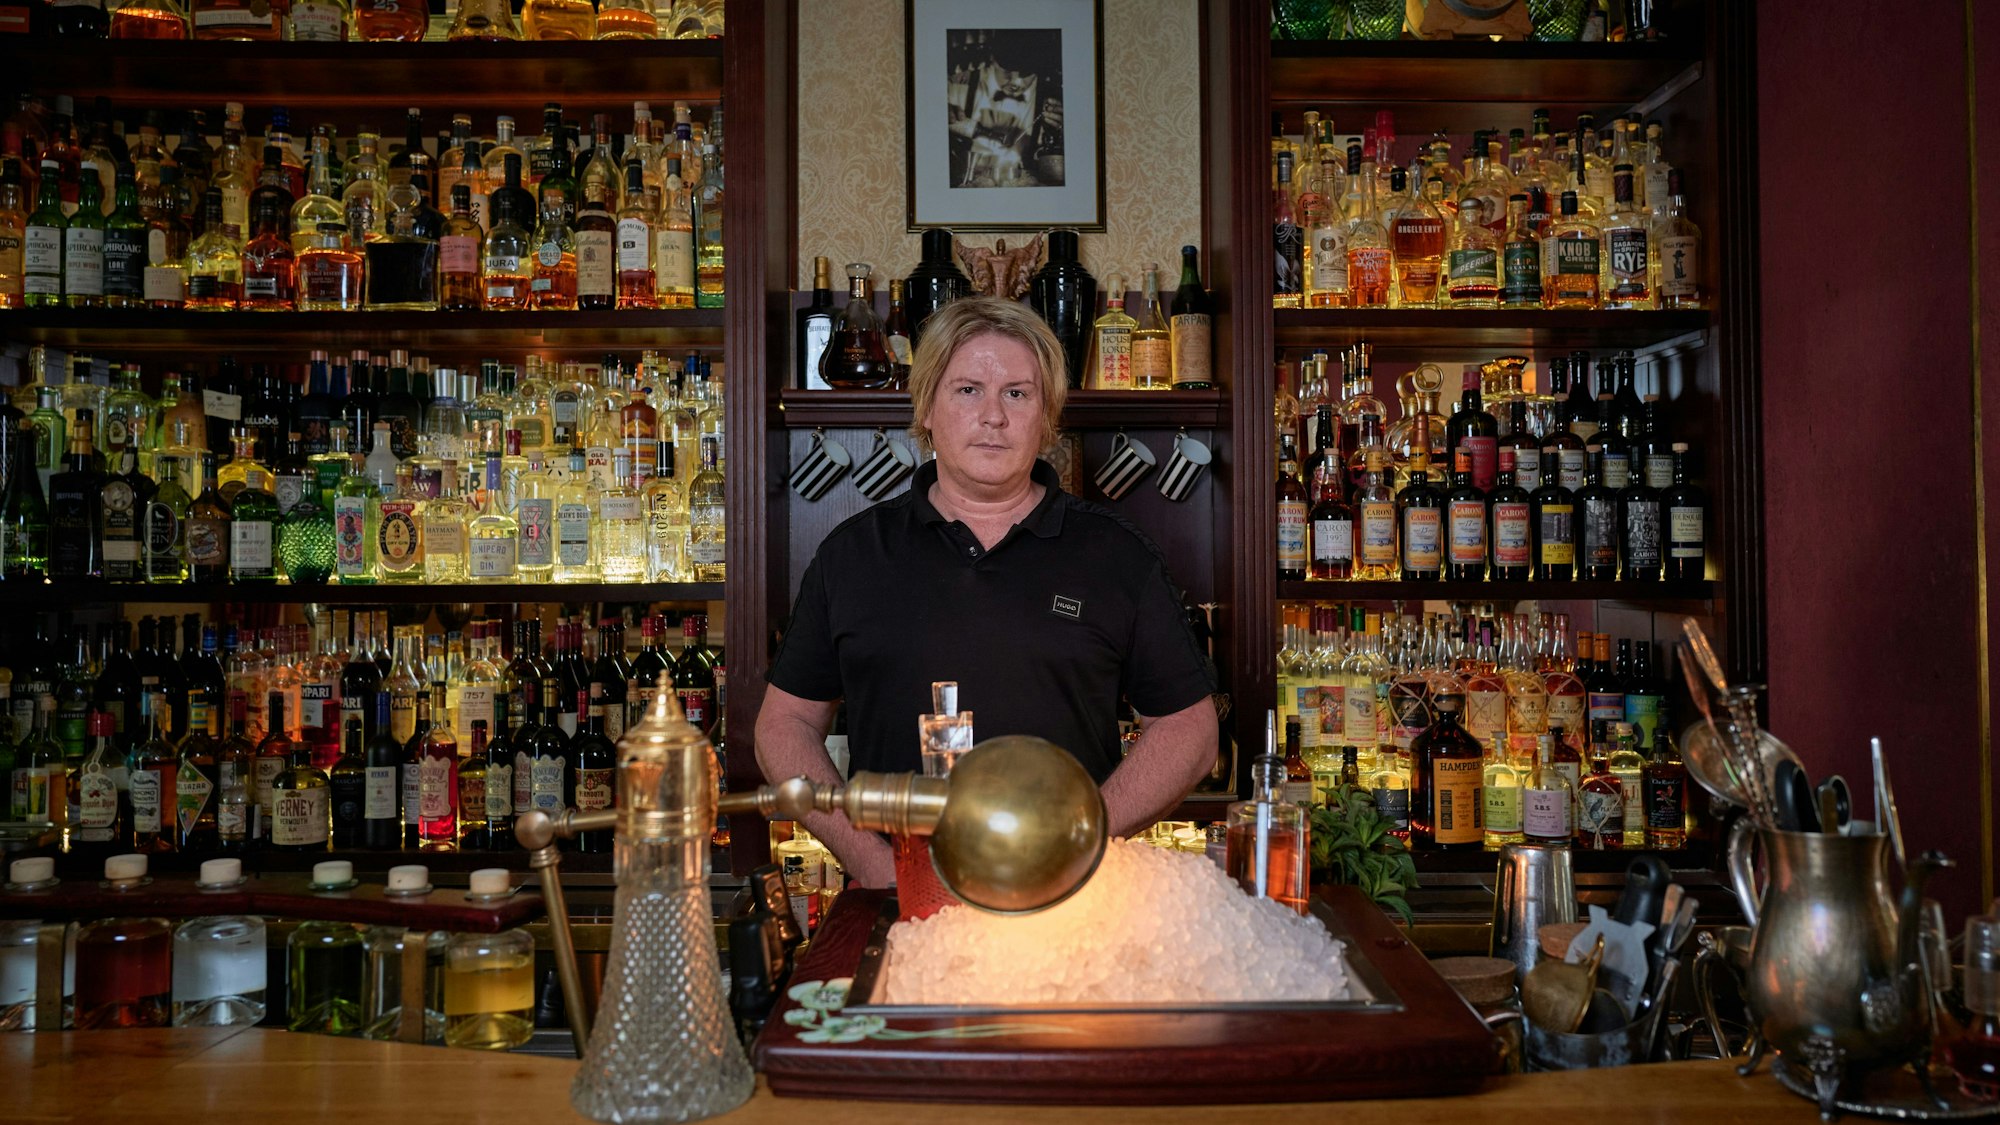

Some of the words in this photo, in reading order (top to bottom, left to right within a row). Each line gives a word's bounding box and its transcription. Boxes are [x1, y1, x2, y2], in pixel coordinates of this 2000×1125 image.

[1559, 242, 1590, 256] KNOB
[1614, 253, 1646, 272] RYE
[480, 561, 494, 570] GIN
[1056, 602, 1076, 611] HUGO
[28, 683, 51, 692] PRAT
[302, 687, 330, 697] MPARI
[1440, 762, 1480, 772] HAMPDEN
[275, 799, 314, 816] VERNEY
